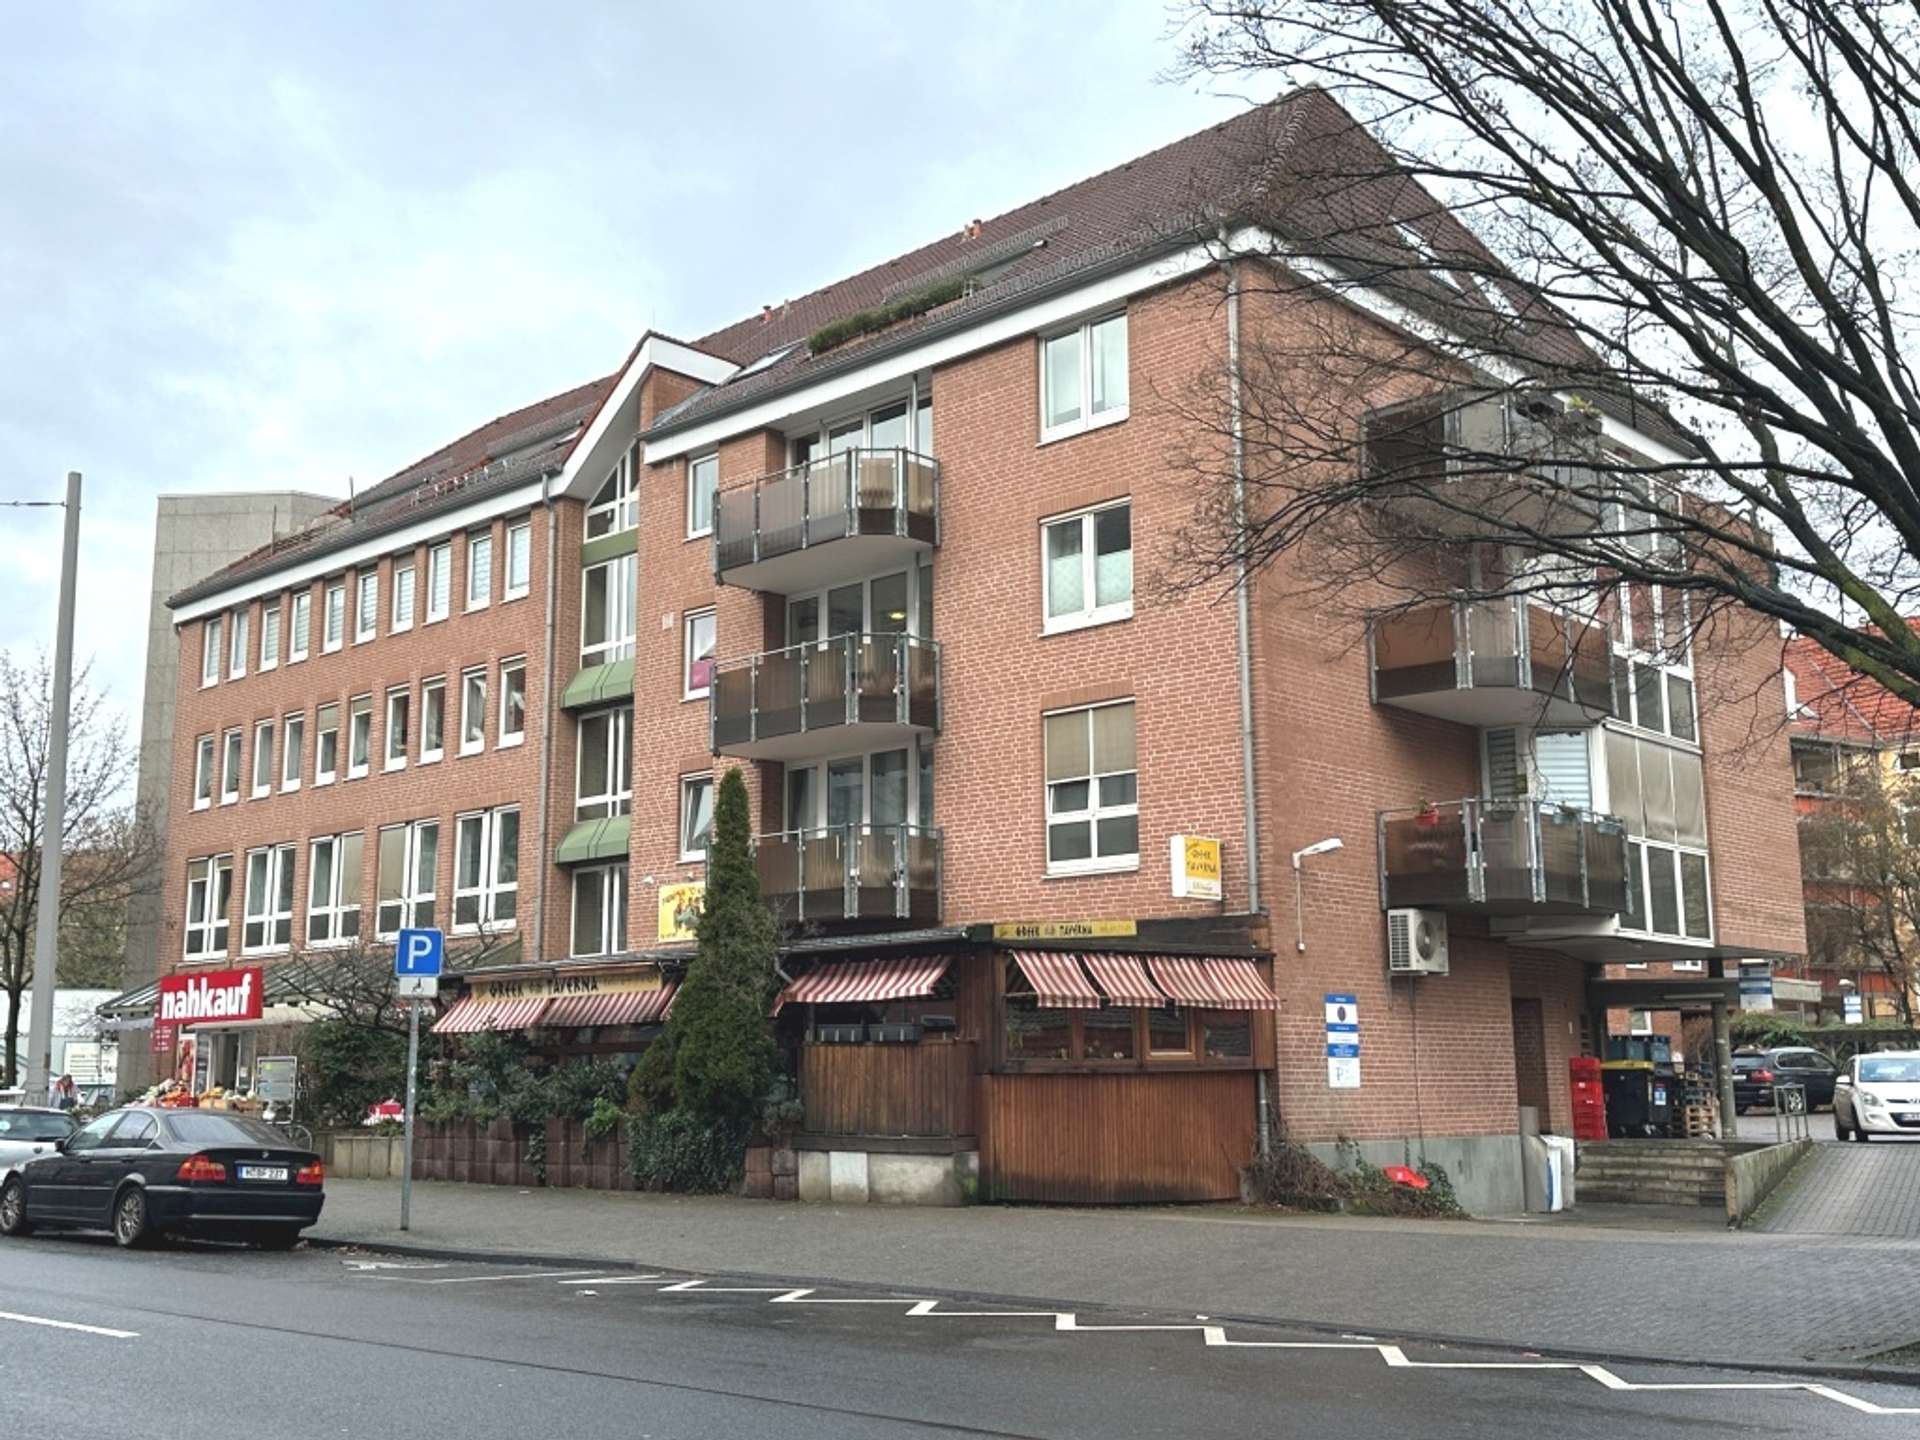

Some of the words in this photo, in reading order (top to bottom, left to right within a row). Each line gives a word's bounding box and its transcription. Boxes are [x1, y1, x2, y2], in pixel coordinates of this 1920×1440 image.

[1060, 923, 1093, 936] TAVERNA
[407, 935, 432, 969] P
[161, 973, 251, 1019] nahkauf
[489, 983, 523, 997] GREEK
[548, 976, 599, 995] TAVERNA
